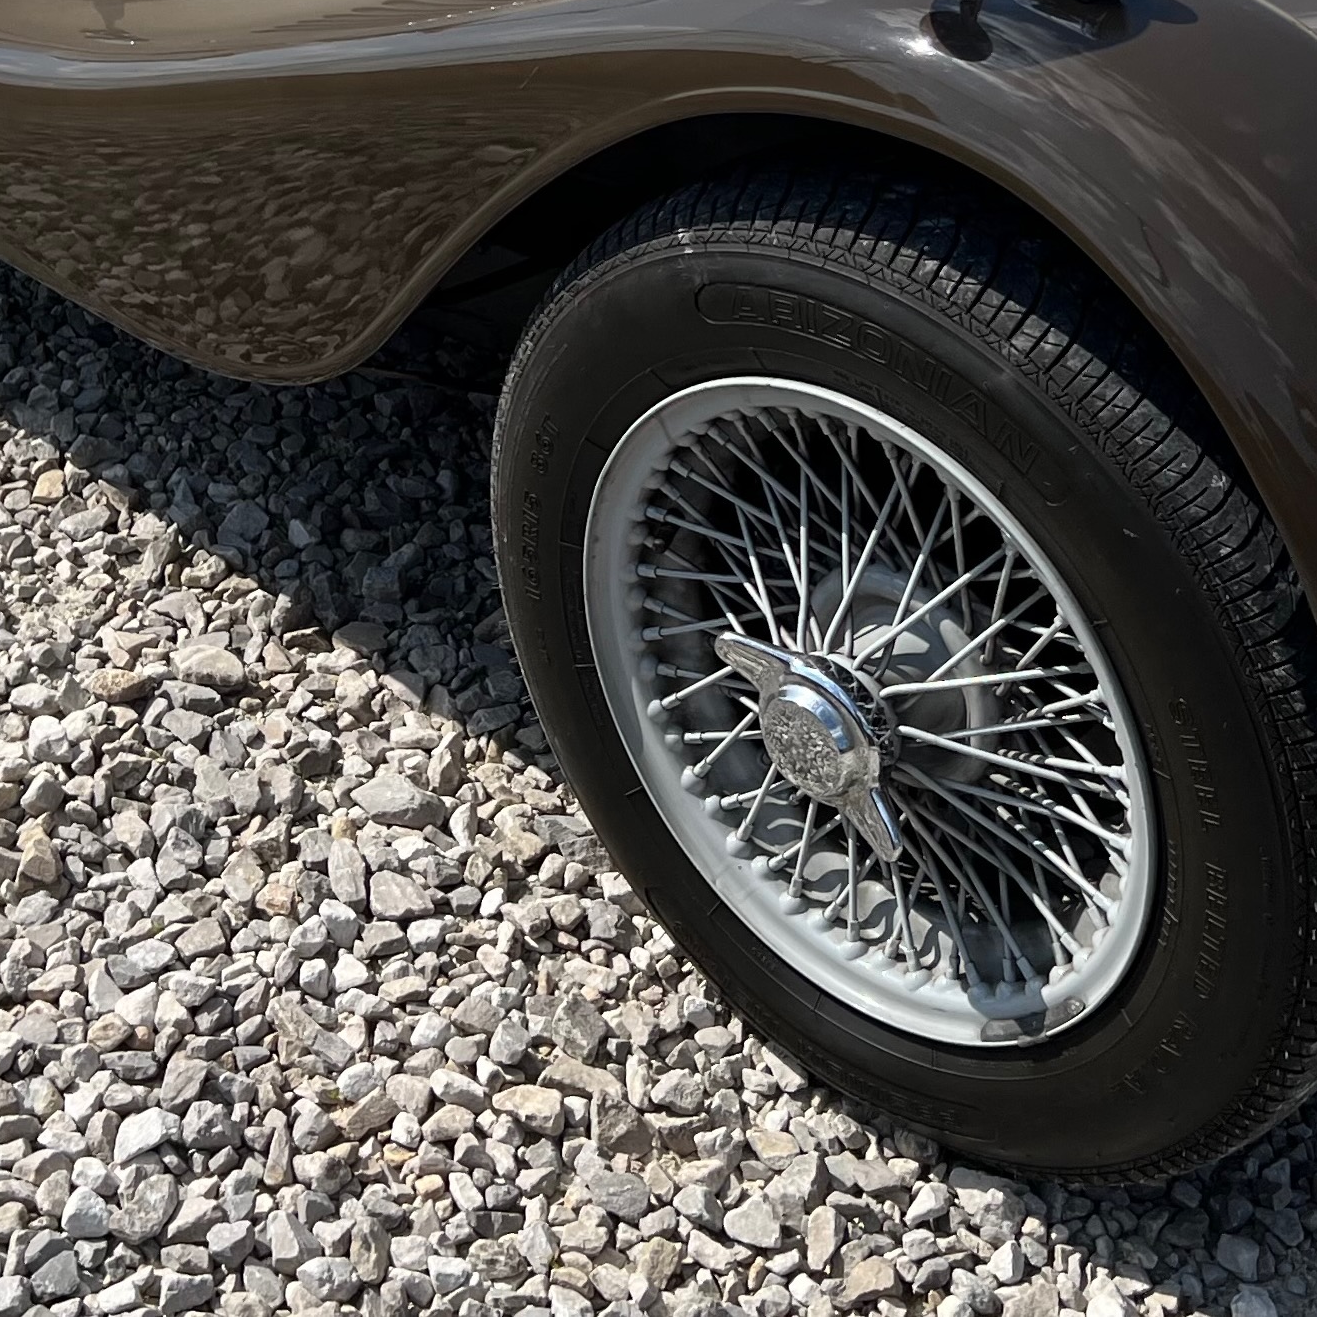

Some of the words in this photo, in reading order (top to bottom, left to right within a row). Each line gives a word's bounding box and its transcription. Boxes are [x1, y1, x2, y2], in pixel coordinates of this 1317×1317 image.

[731, 285, 1046, 476] ARIZONIAN
[519, 489, 543, 601] 165R15
[1166, 695, 1222, 834] STEEL
[1194, 860, 1228, 1001] BELTED
